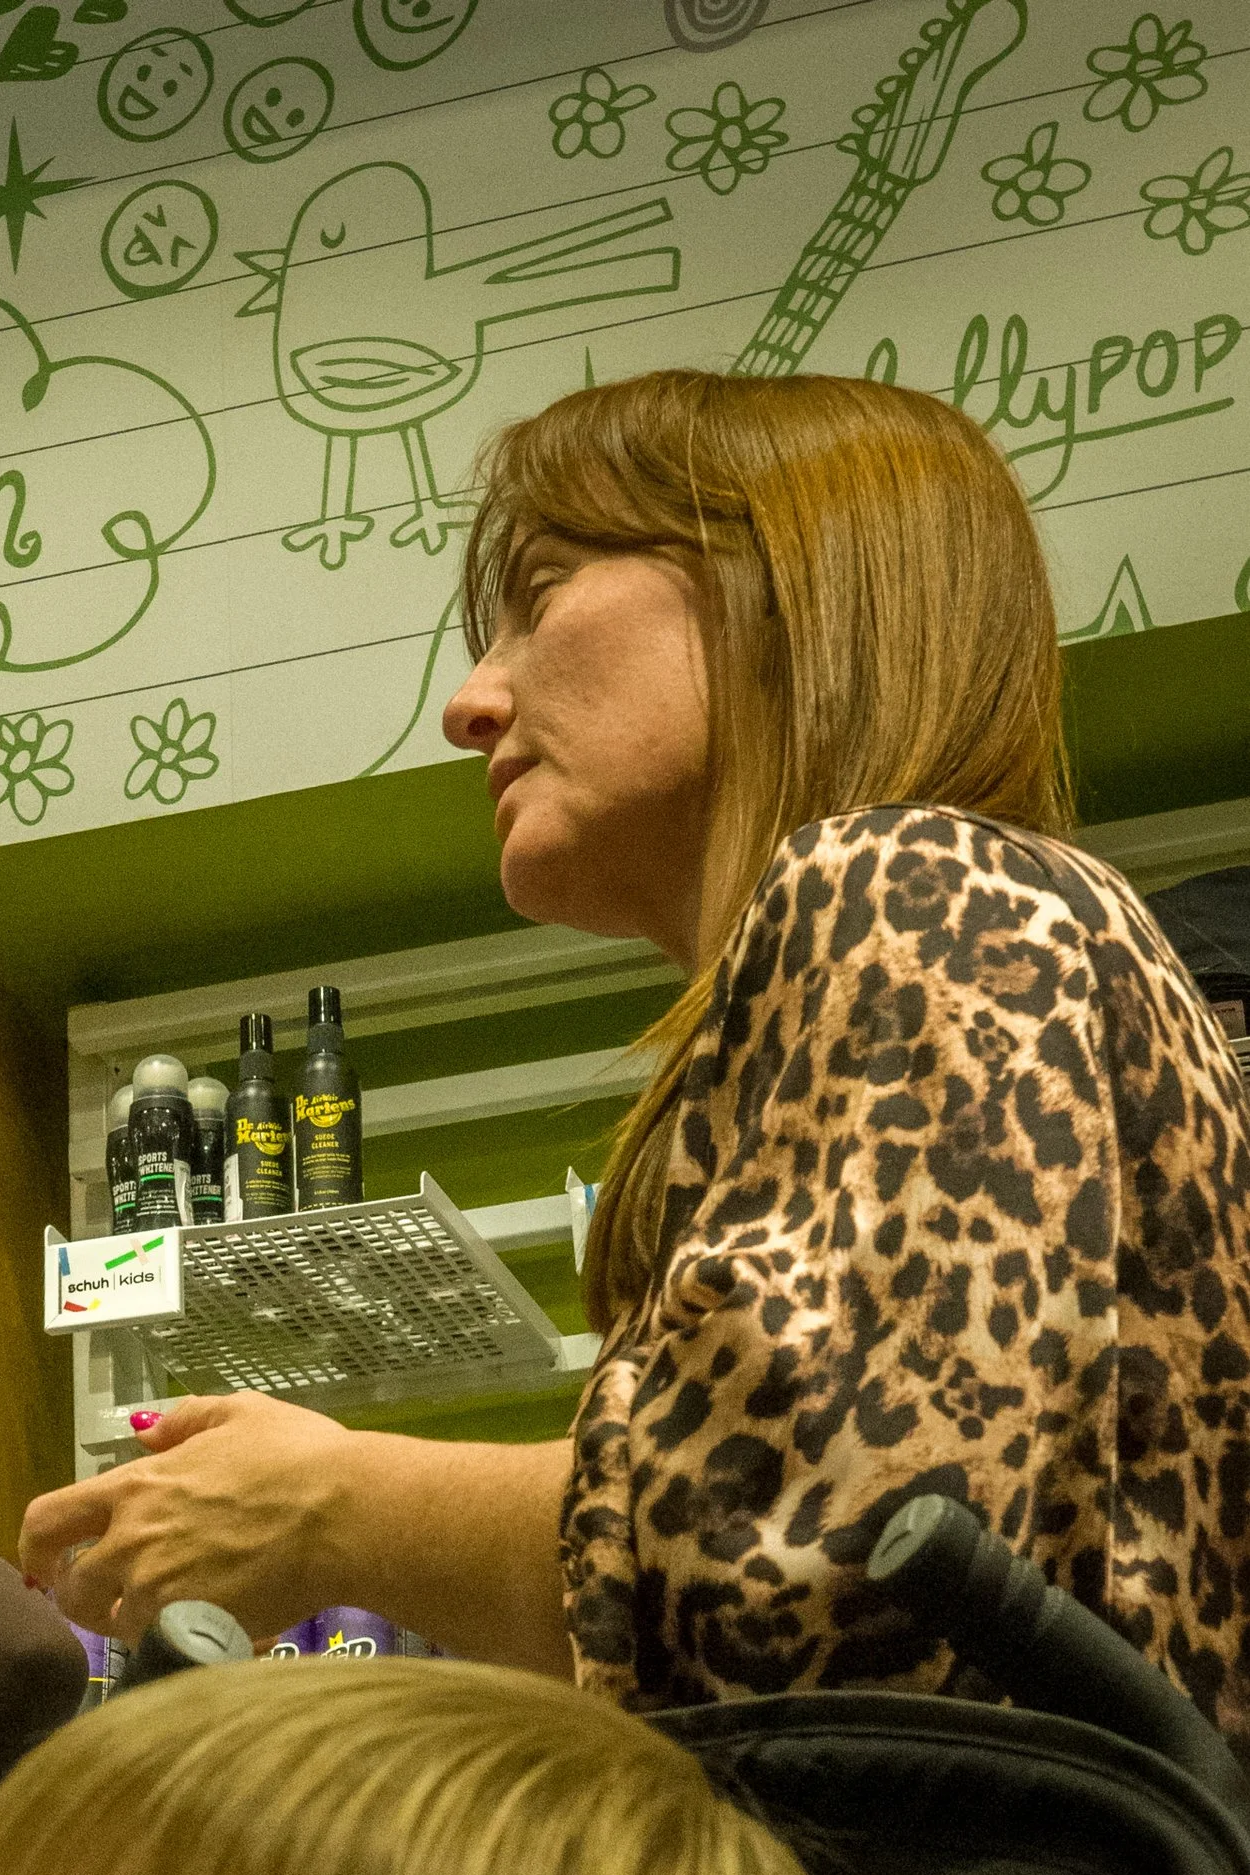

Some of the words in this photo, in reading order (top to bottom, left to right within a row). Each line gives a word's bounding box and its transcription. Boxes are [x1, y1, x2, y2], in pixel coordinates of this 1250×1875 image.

[295, 1099, 355, 1123] Martens
[311, 1141, 339, 1150] CLEANER
[138, 1151, 167, 1166] SPORTS
[138, 1162, 175, 1175] WHITENE
[68, 1277, 109, 1293] schuh
[119, 1271, 155, 1286] kids
